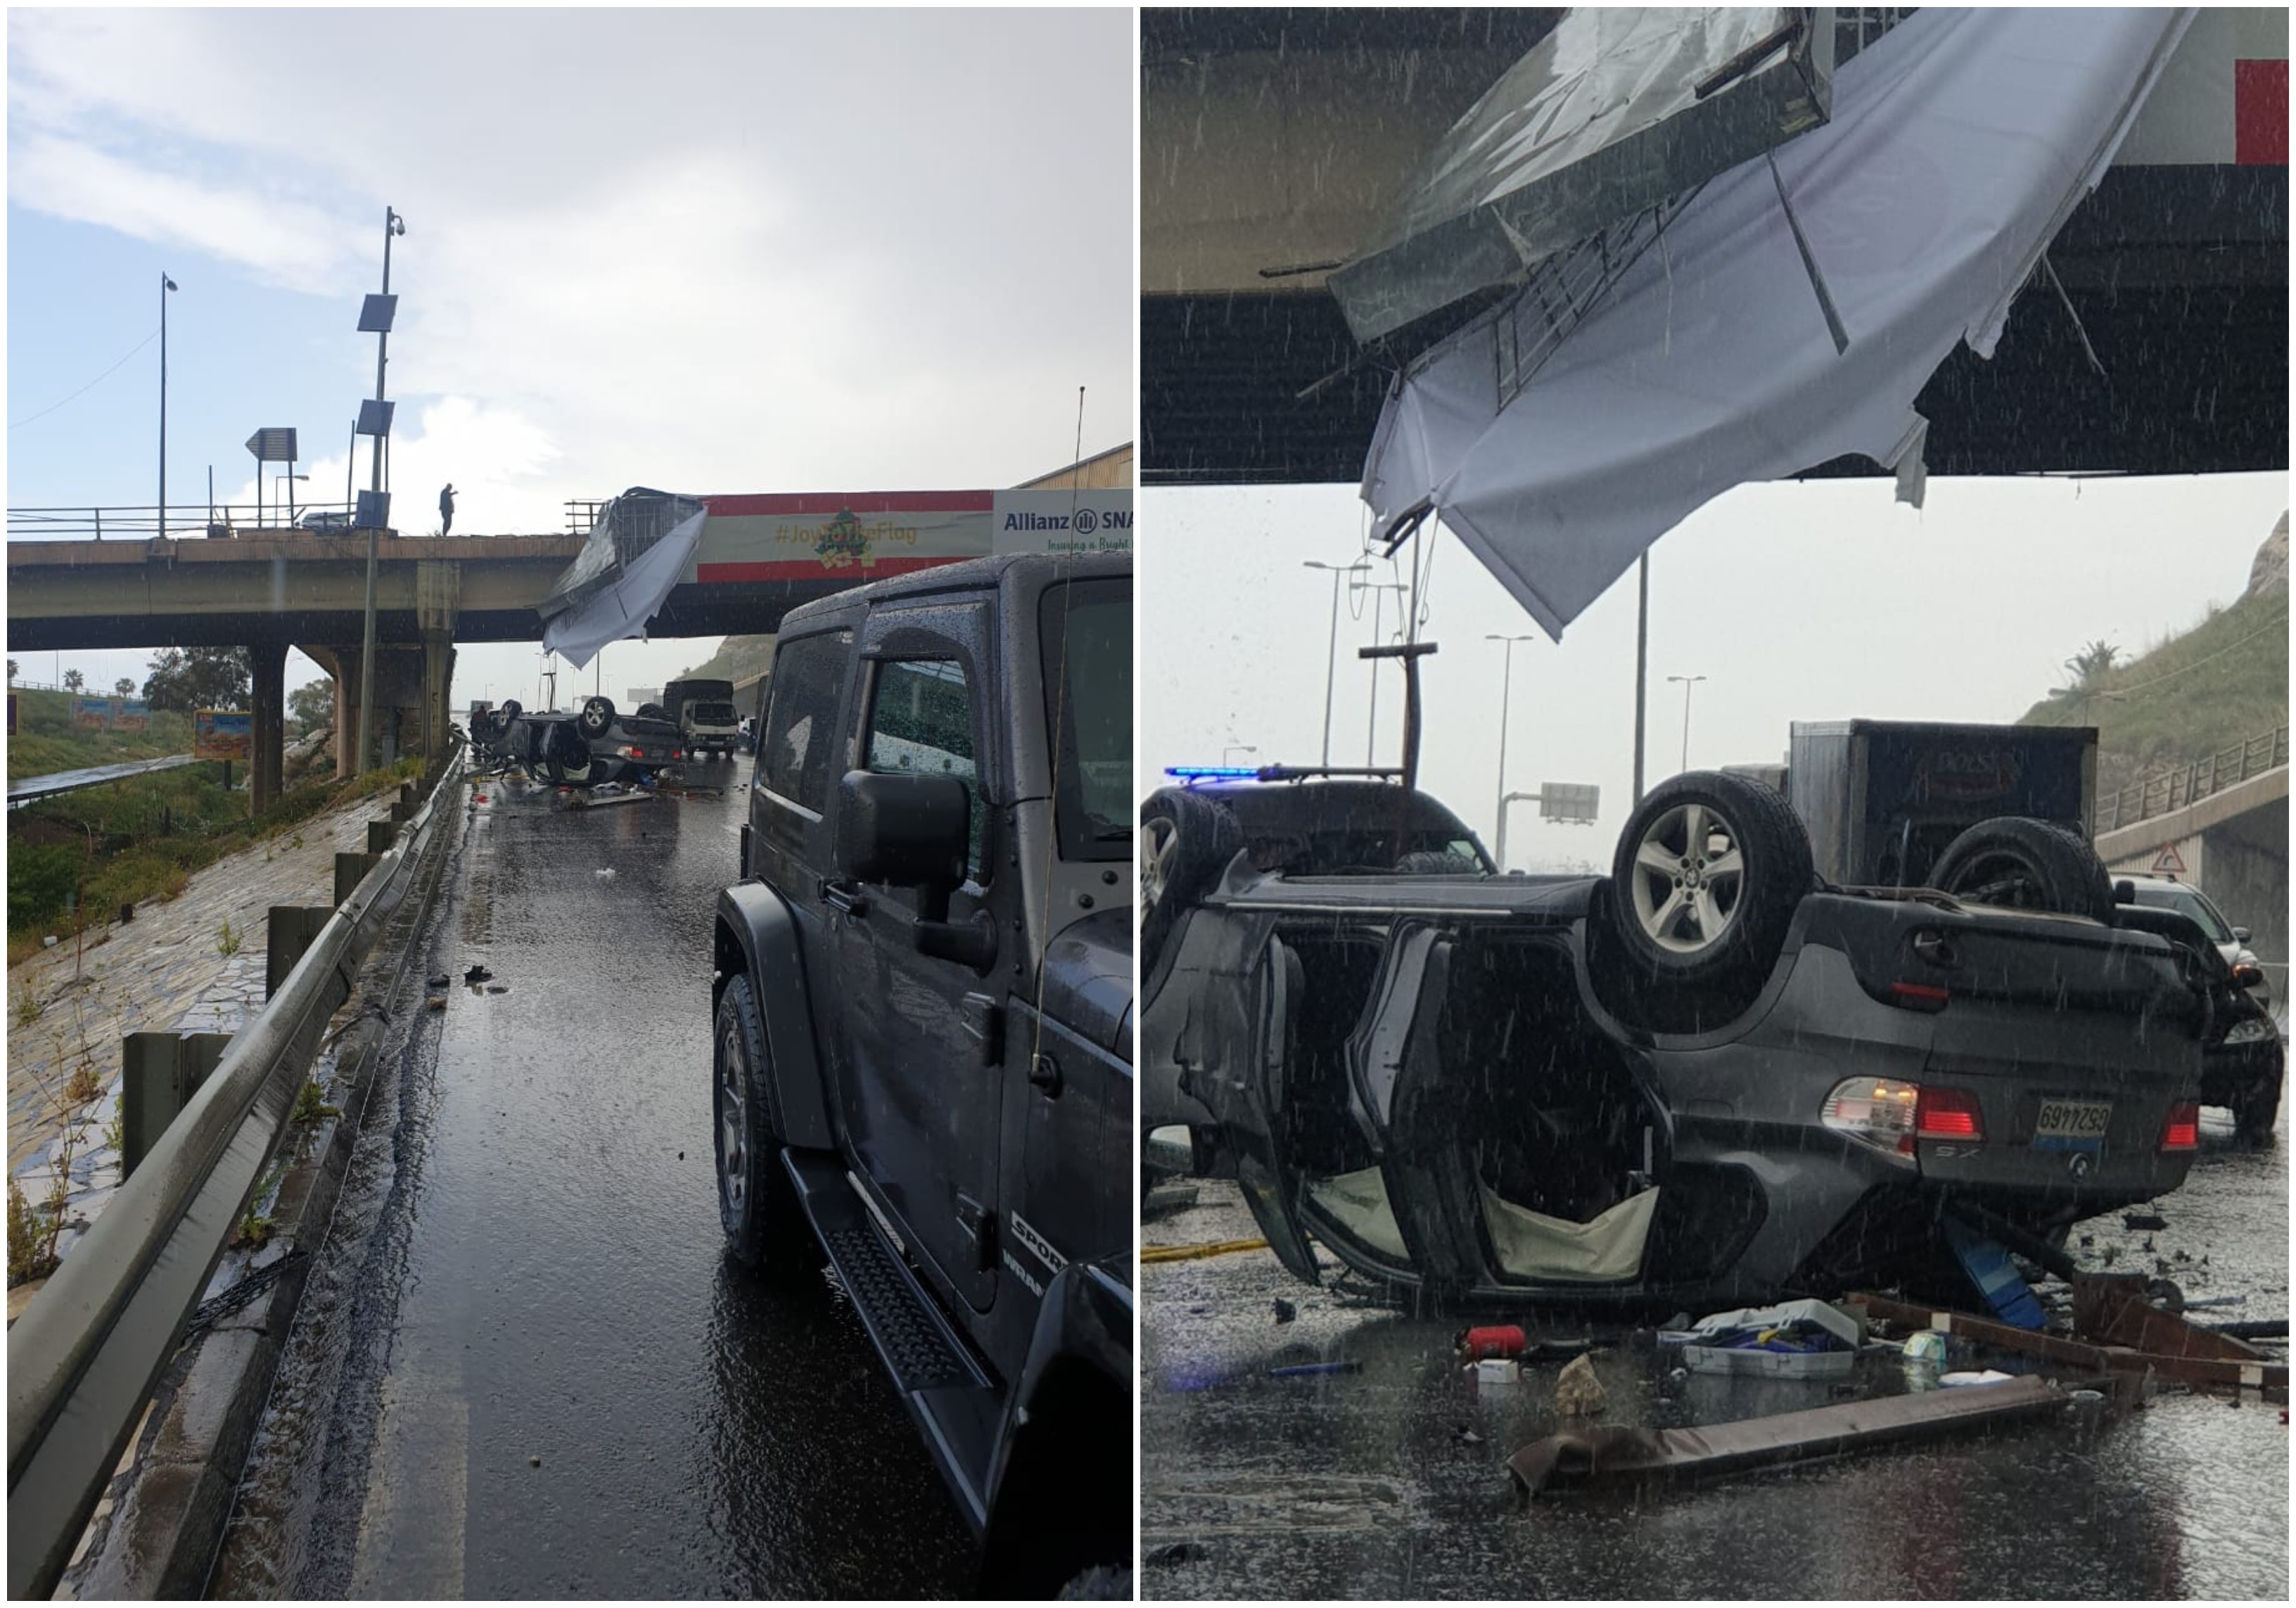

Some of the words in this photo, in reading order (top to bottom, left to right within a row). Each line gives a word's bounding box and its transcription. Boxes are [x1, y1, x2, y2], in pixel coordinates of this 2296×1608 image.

[777, 521, 917, 547] #JoyTTheFlag
[1005, 513, 1069, 531] Allianz
[1099, 537, 1128, 551] Bright
[1012, 1220, 1065, 1270] SPOR
[1002, 1249, 1045, 1298] WRAN
